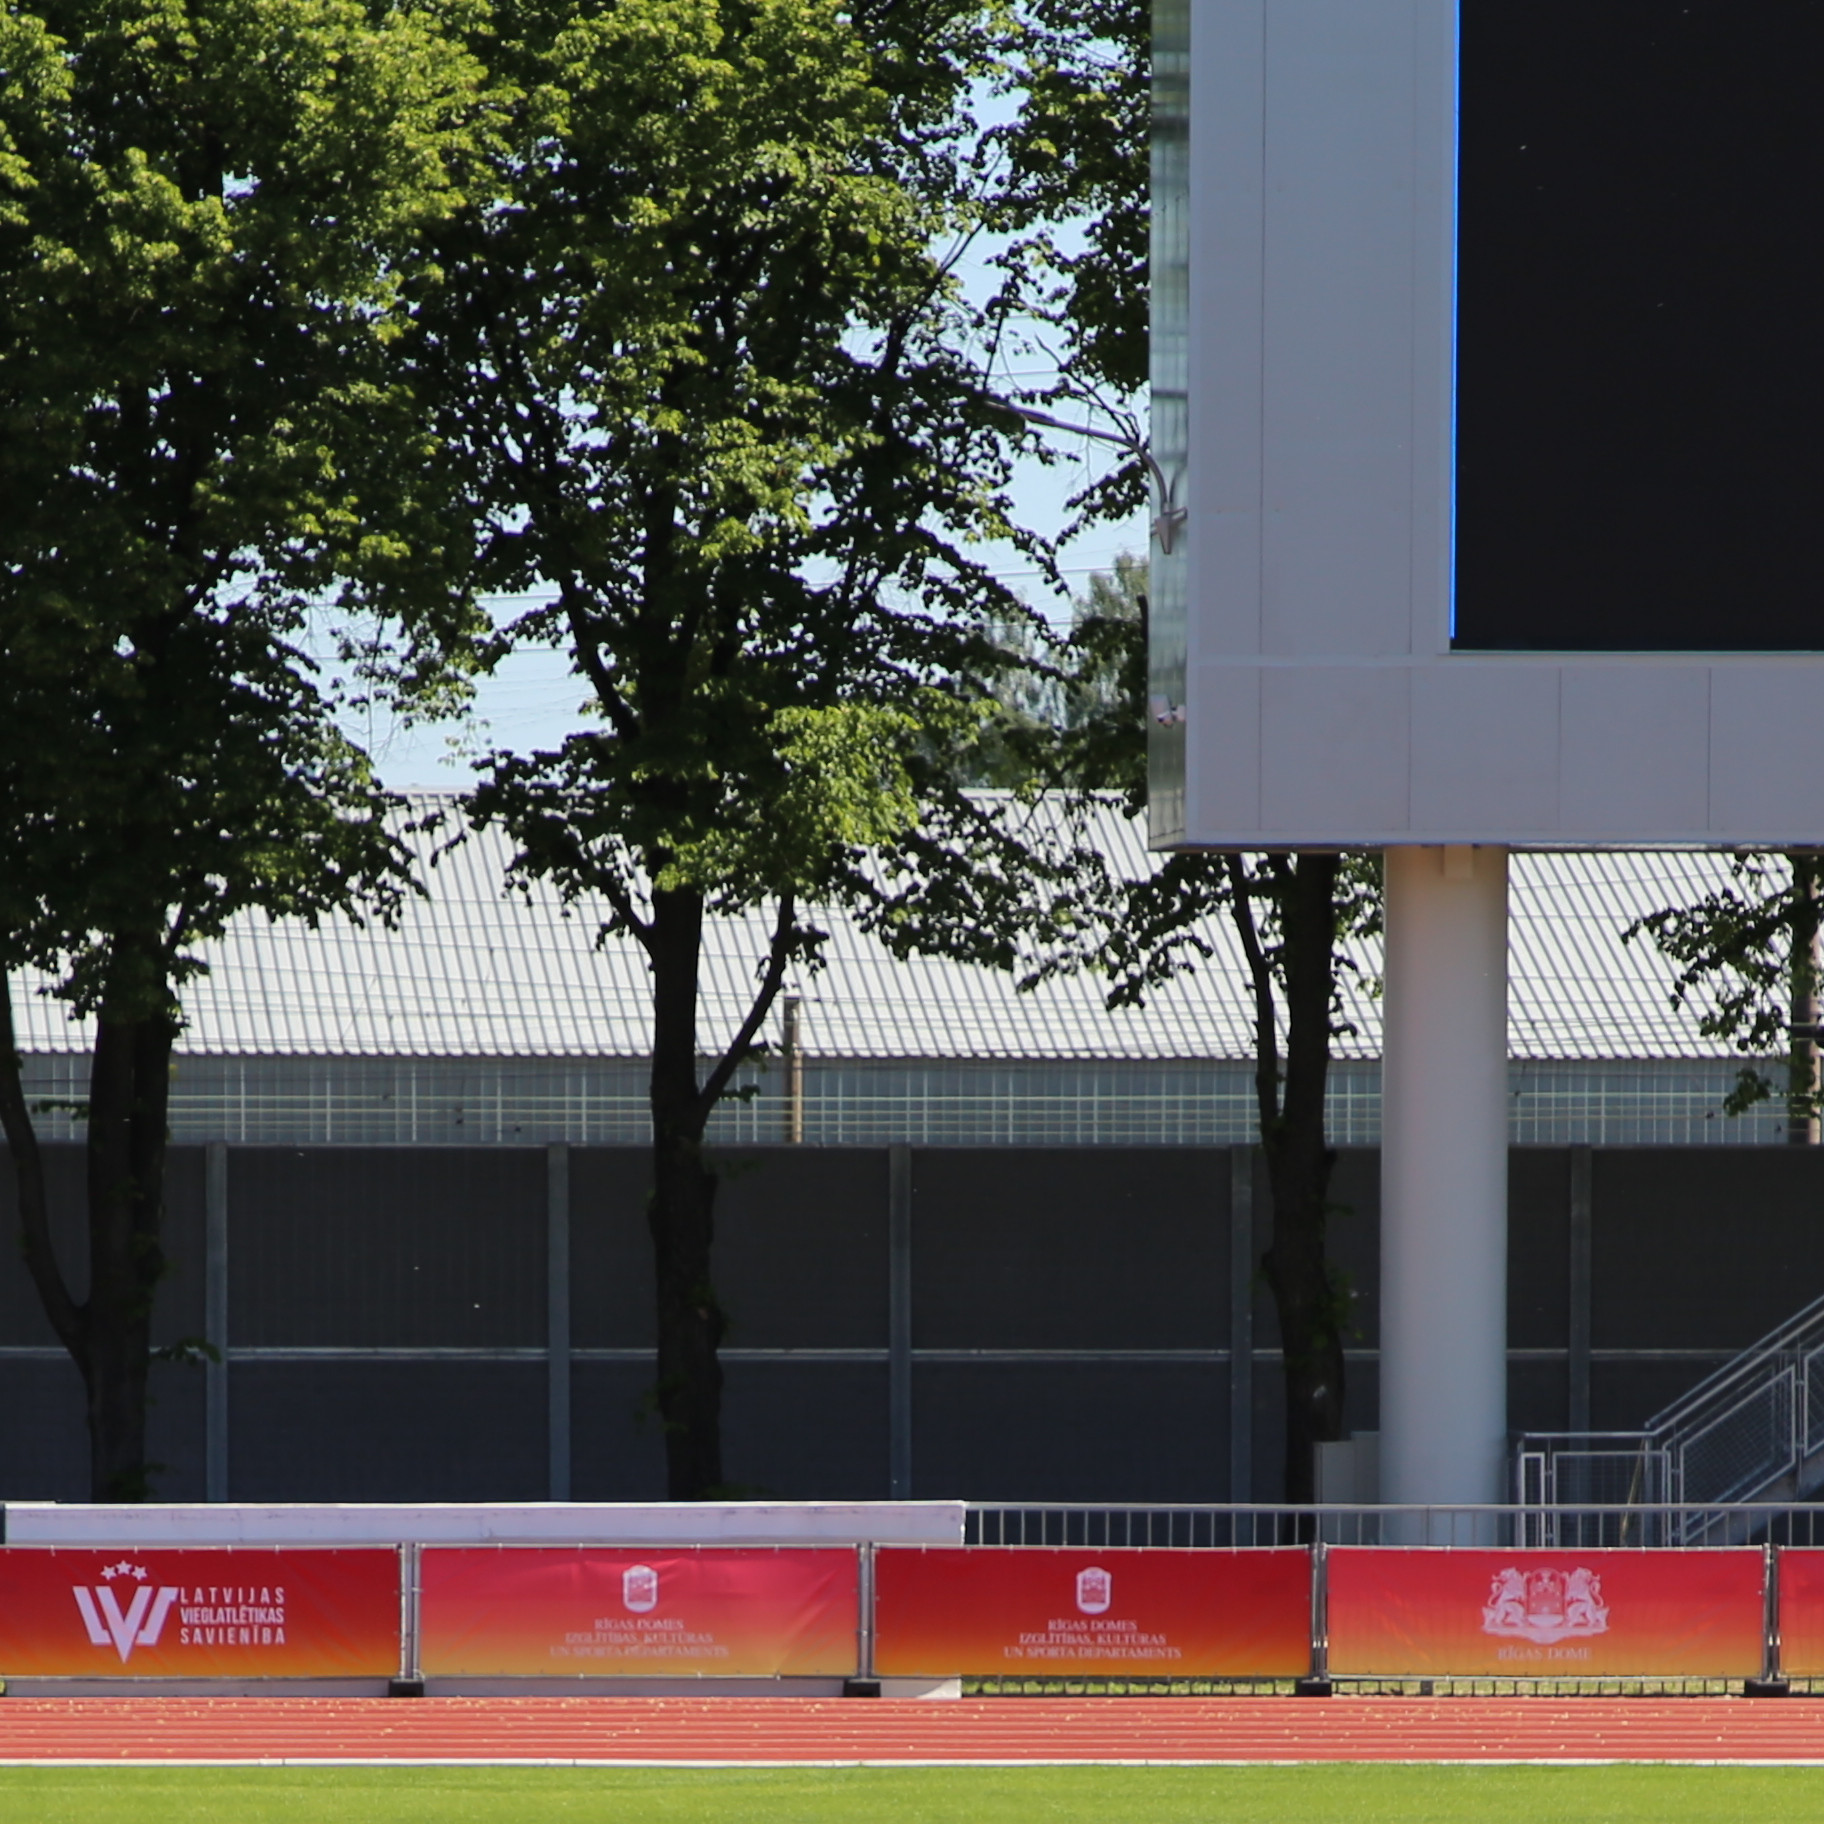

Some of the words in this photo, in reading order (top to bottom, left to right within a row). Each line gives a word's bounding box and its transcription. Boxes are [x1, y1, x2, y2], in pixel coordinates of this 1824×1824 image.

[180, 1587, 285, 1604] LATVIJAS
[180, 1605, 284, 1624] VIEGLATLĒTIKAS
[180, 1625, 285, 1645] SAVIENĪBA
